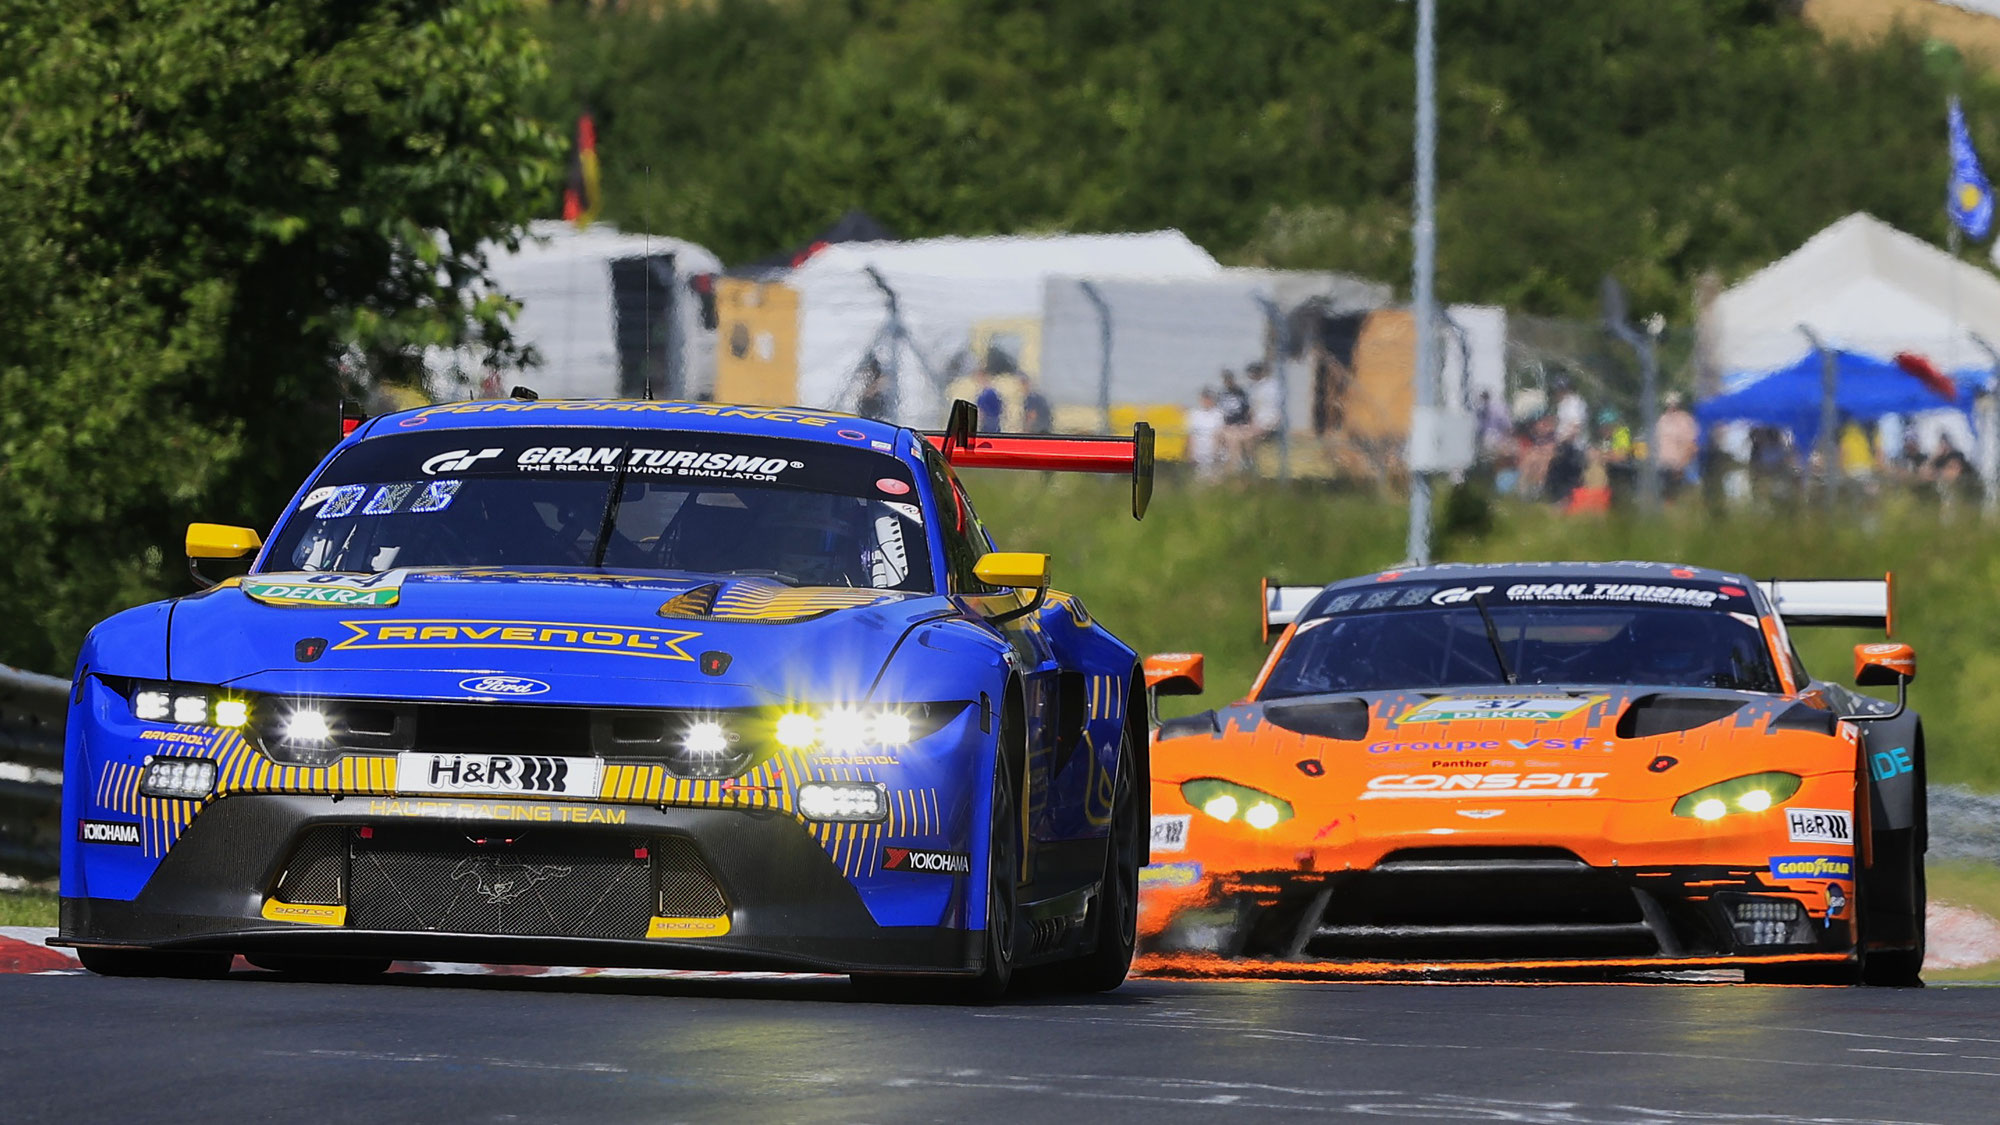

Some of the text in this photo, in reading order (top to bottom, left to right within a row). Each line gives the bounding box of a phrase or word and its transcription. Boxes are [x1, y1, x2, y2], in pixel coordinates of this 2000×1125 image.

[415, 401, 838, 427] PERFORMANCE
[517, 447, 623, 465] GRAN
[517, 464, 551, 472] THE
[555, 464, 599, 472] REAL
[677, 469, 777, 482] SIMULATOR
[261, 585, 377, 605] DEKRA
[1506, 583, 1588, 597] GRAN
[475, 677, 532, 694] Ford
[1473, 700, 1532, 710] 37
[1453, 711, 1551, 720] DEKRA
[1368, 739, 1500, 754] Groupe
[430, 755, 515, 787] H&R
[1432, 760, 1489, 769] Panther
[369, 800, 627, 825] HAUPT RACING TEAM
[83, 823, 140, 843] YOKOHAMA
[1791, 815, 1827, 833] H&R
[908, 851, 970, 873] YOKOHAMA
[1777, 858, 1850, 877] GOODYEAR
[273, 905, 335, 917] sparco
[656, 922, 716, 930] sparco
